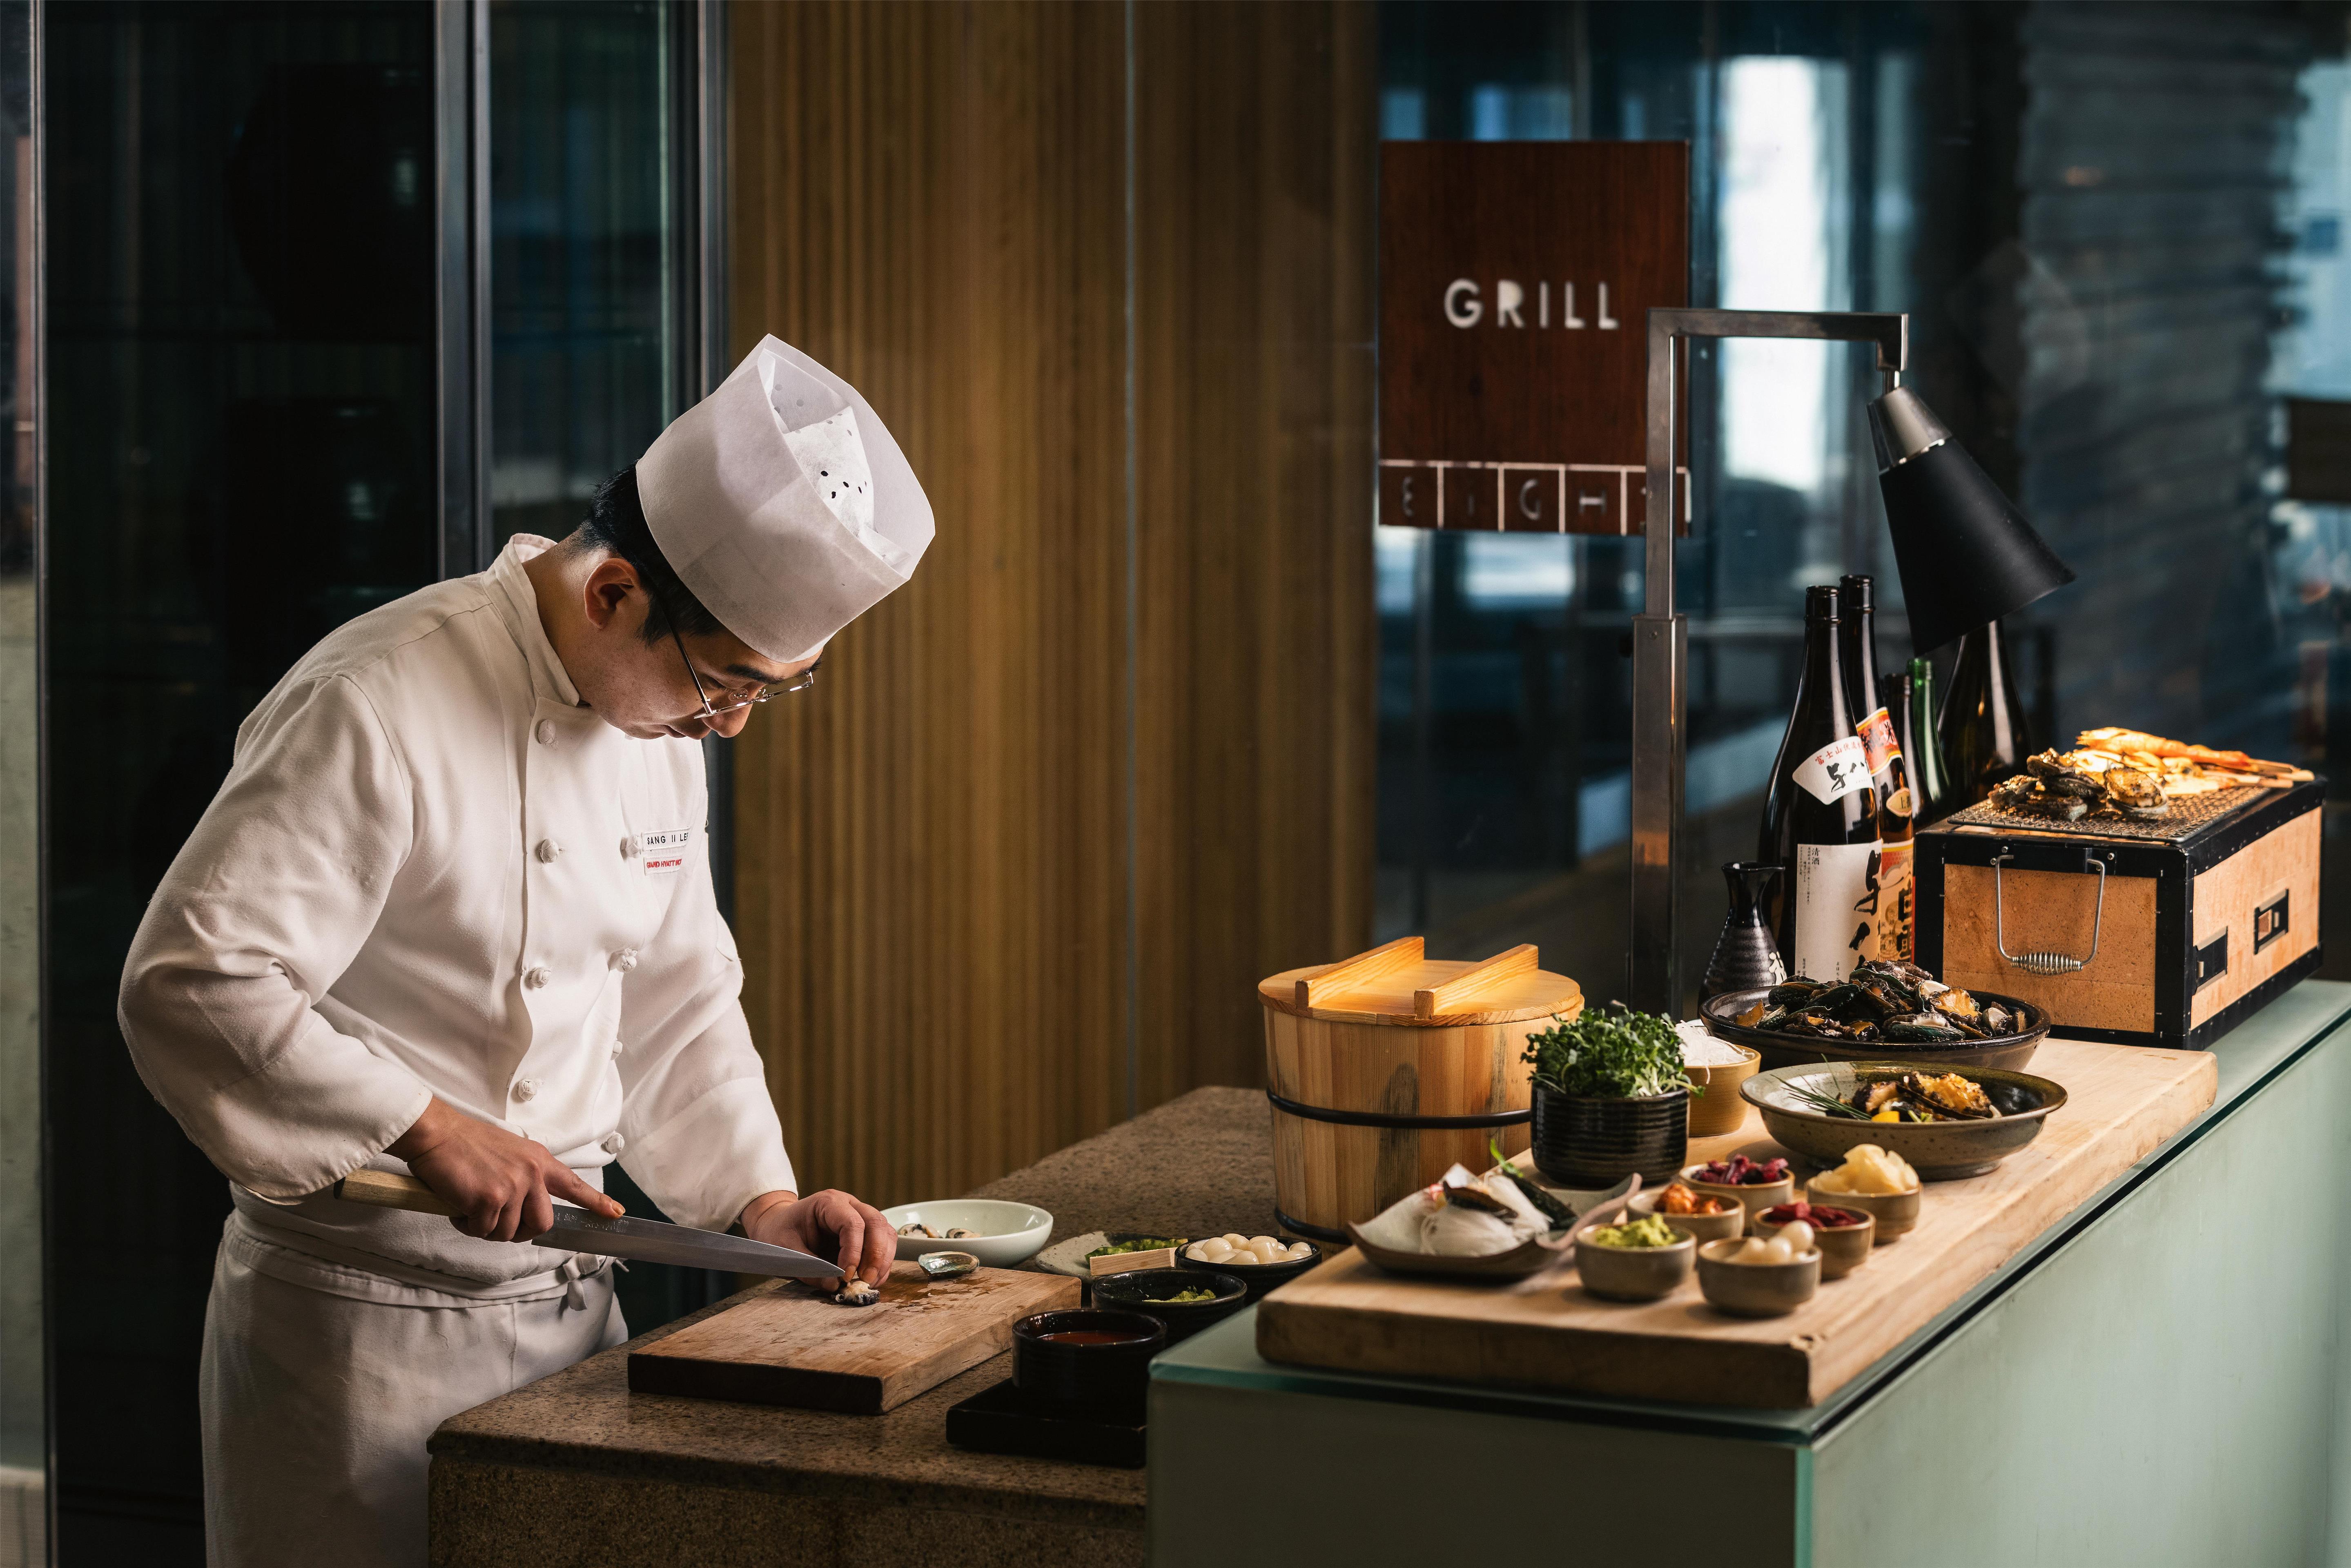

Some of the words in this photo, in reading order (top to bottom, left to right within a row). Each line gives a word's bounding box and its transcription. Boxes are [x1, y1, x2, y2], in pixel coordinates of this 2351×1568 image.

[1444, 278, 1620, 330] GRILL
[1402, 476, 1647, 520] EIGH
[647, 835, 666, 845] SANG
[1812, 848, 1820, 865] 清酒
